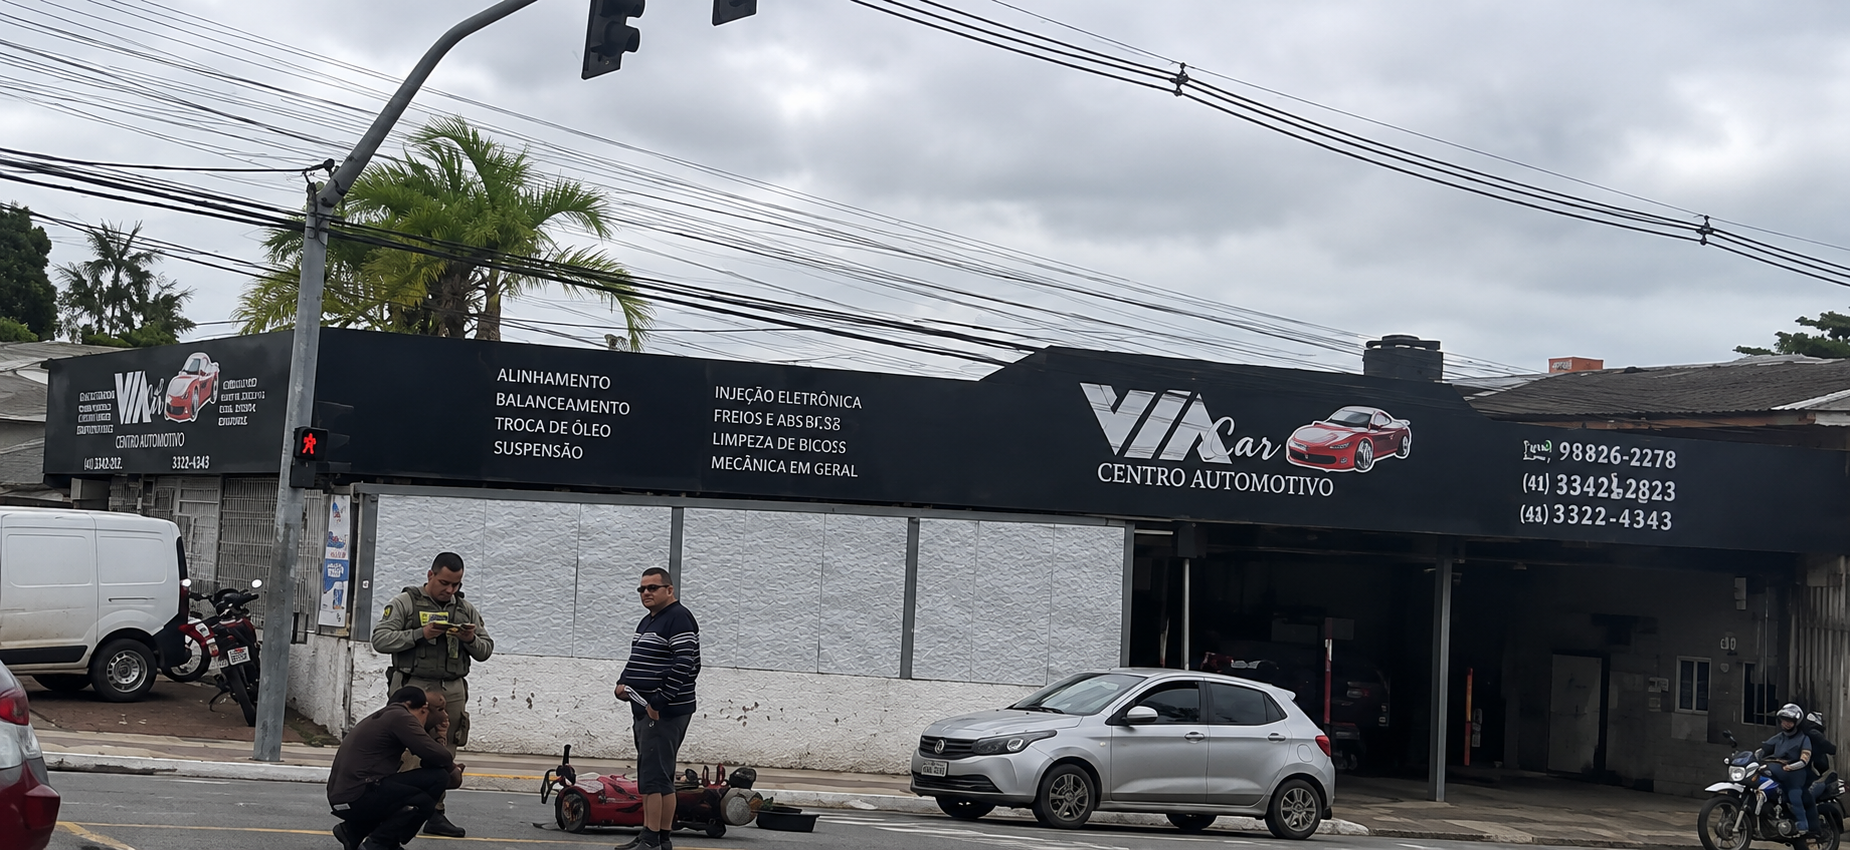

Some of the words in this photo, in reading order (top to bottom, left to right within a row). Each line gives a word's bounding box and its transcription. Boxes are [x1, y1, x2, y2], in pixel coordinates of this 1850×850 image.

[497, 368, 611, 390] ALINHAMENTO
[114, 371, 152, 425] VIA
[496, 392, 630, 415] BALANCEAMENTO
[715, 385, 774, 405] INJEÇÃO
[778, 389, 862, 409] ELETRÔNICA
[495, 416, 546, 433] TROCA
[549, 420, 569, 435] DE
[571, 418, 611, 438] ÓLEO
[714, 409, 763, 425] FREIOS
[766, 413, 774, 426] E
[777, 414, 803, 428] ABS
[1080, 383, 1232, 464] VIA
[1202, 416, 1281, 461] Car
[115, 434, 139, 449] CENTRO
[139, 432, 185, 449] AUTOMOTIVO
[493, 440, 583, 460] SUSPENSÃO
[712, 432, 774, 449] LIMPEZA
[777, 436, 796, 451] DE
[711, 454, 786, 473] MECÂNICA
[790, 461, 811, 475] EM
[814, 462, 859, 478] GERAL
[1559, 441, 1677, 469] 98826-2278
[1097, 463, 1186, 487] CENTRO
[1190, 468, 1334, 497] AUTOMOTIVO
[1522, 472, 1550, 496] (41)
[1553, 503, 1673, 531] 3322-4343
